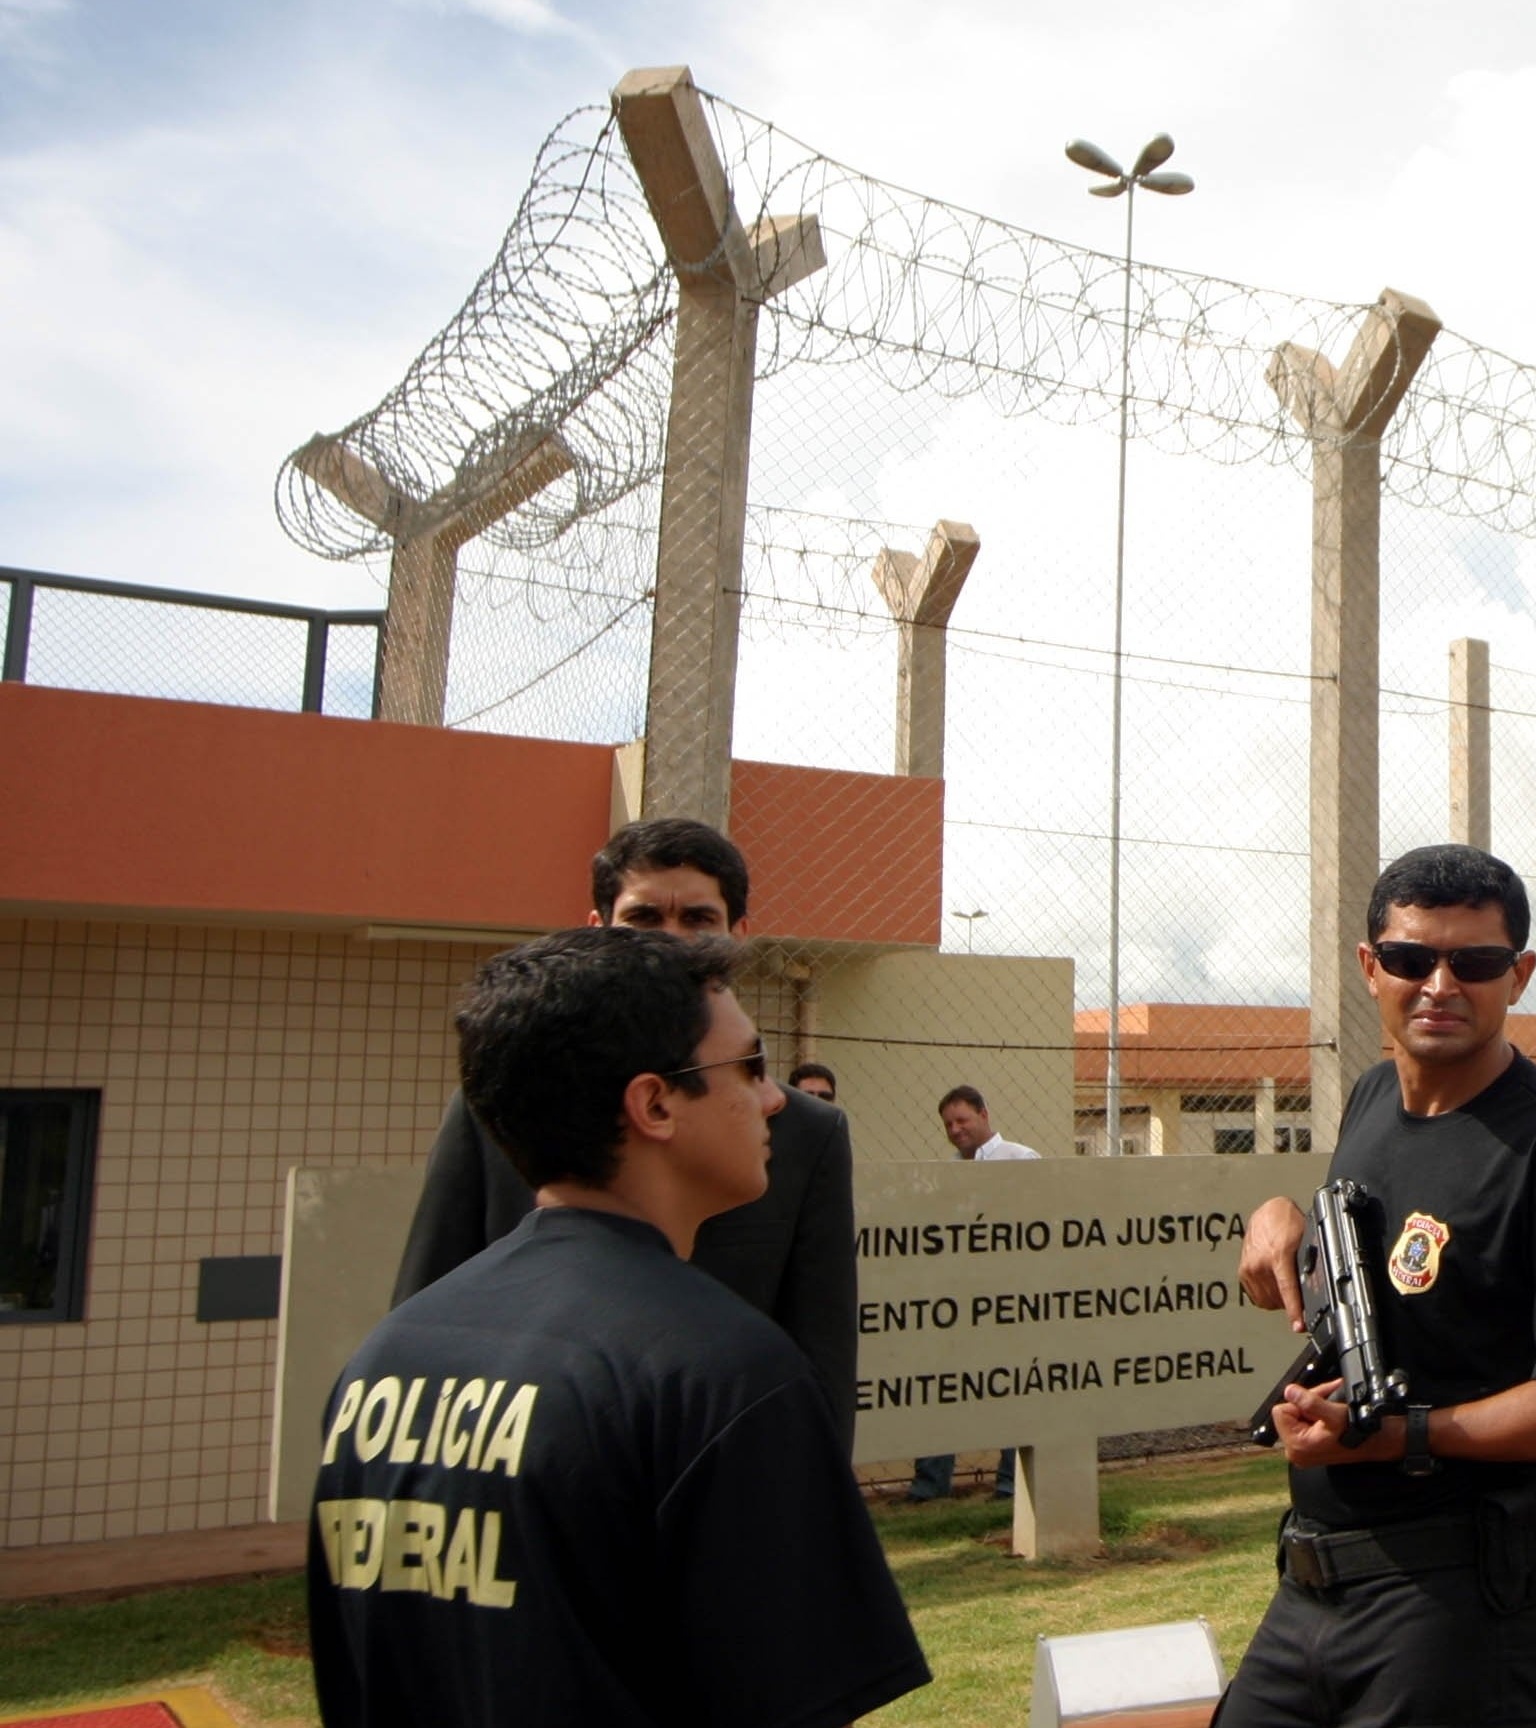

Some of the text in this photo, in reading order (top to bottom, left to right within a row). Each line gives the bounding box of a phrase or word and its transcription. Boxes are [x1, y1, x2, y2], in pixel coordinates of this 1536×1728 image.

[1062, 1218, 1106, 1248] DA
[1117, 1212, 1246, 1252] JUSTIÇA
[859, 1297, 958, 1334] ENTO
[971, 1275, 1229, 1327] PENITENCIÁRIO
[856, 1347, 1253, 1410] ENITENCIÁRIA FEDERAL
